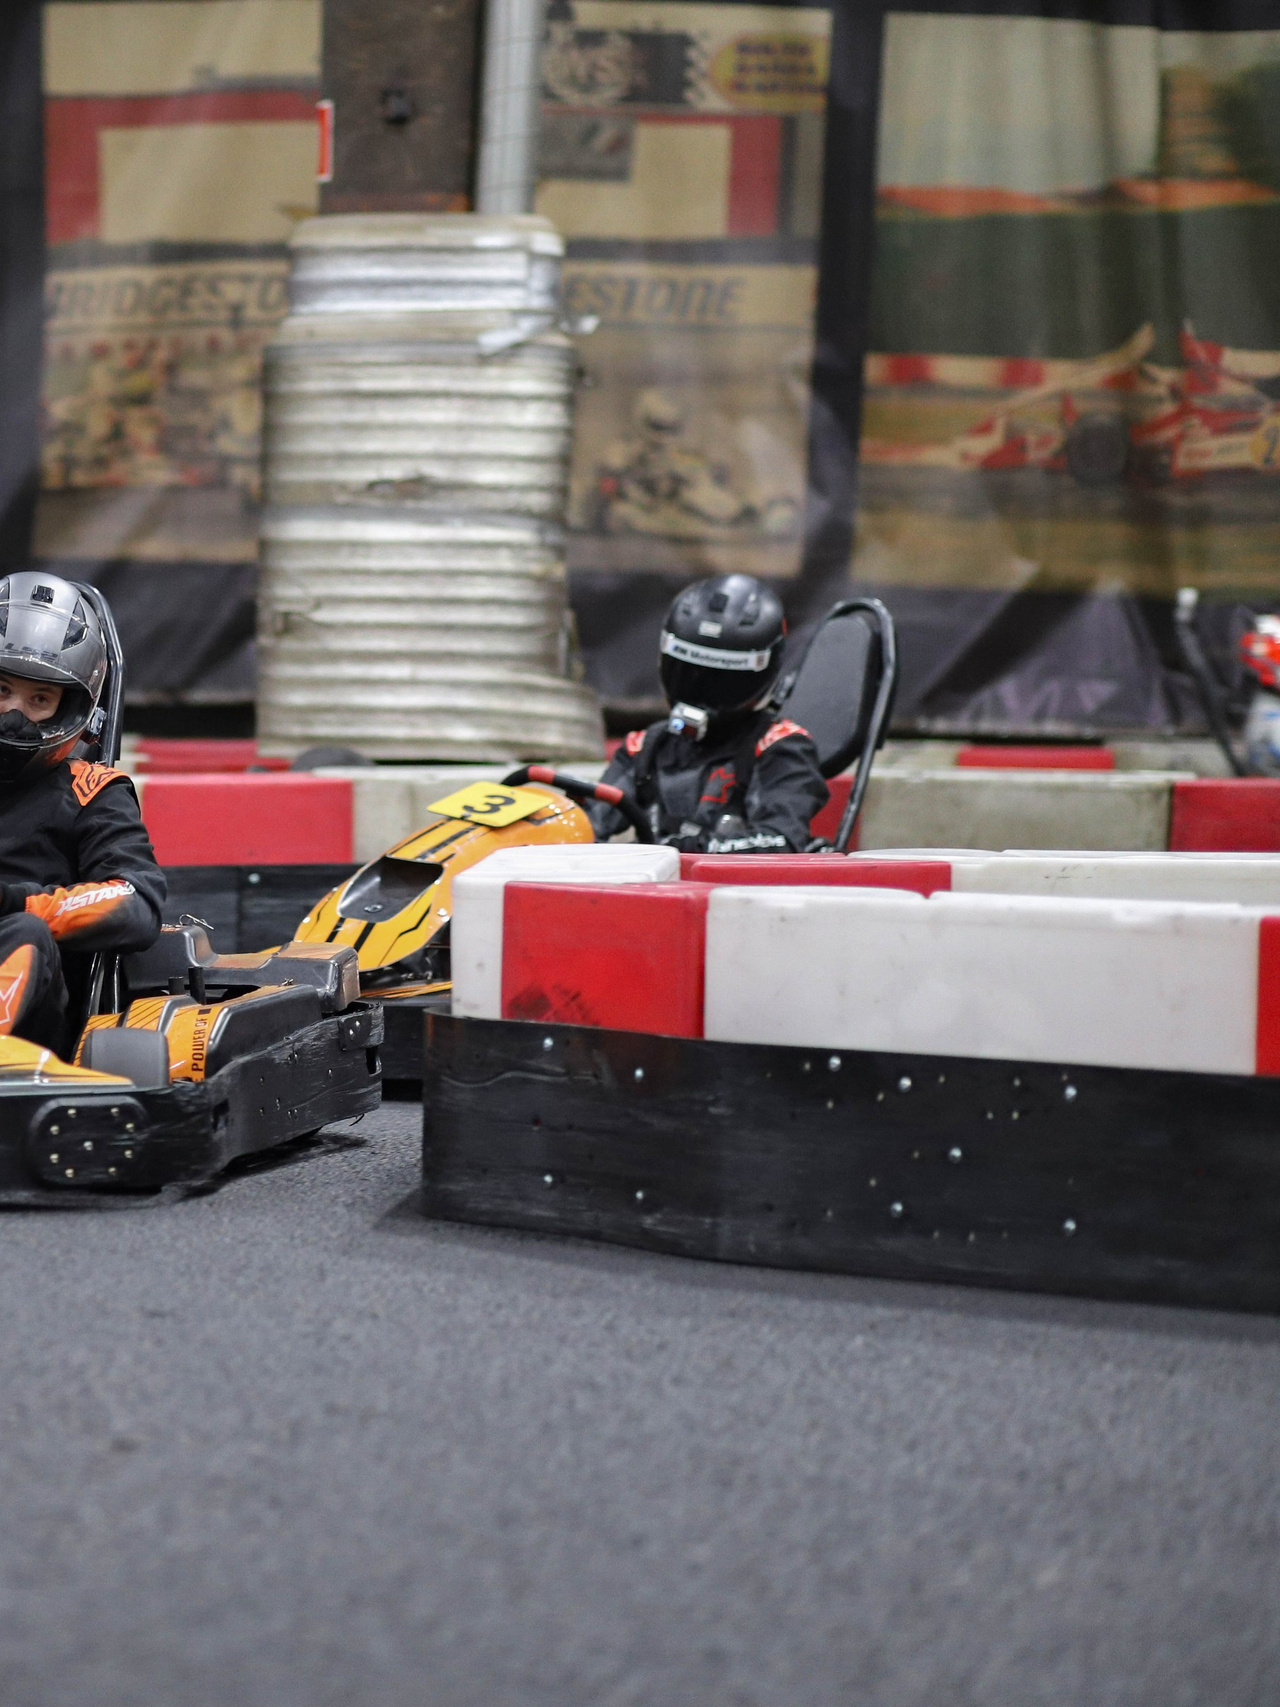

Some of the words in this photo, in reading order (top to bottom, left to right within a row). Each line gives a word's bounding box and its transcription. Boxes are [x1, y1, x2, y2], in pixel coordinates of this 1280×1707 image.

[43, 275, 289, 320] BRIDGESTO
[563, 274, 746, 318] ESTONE
[462, 795, 516, 814] 3
[191, 1028, 206, 1072] POWER
